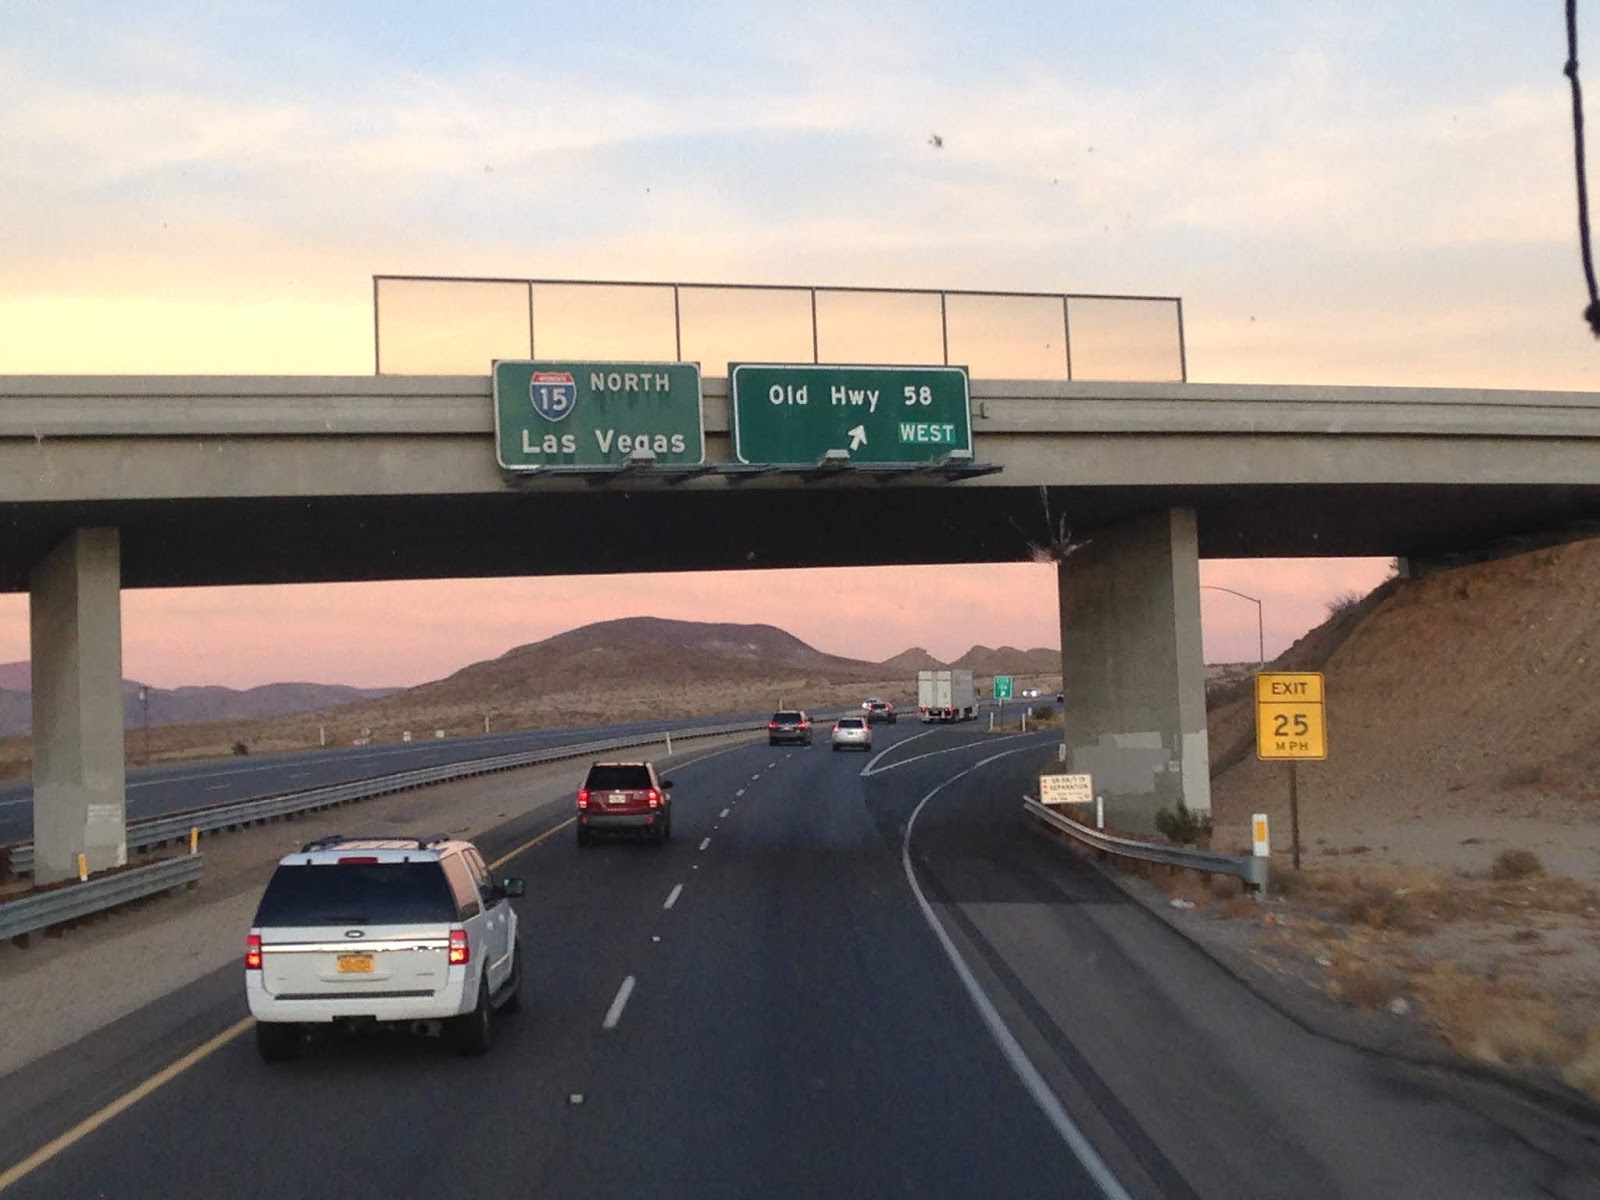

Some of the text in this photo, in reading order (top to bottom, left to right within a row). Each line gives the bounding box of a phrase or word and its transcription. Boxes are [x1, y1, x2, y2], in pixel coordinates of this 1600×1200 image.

[590, 373, 669, 392] NORTH
[540, 388, 567, 410] 15
[768, 384, 933, 413] Old Hwy 58
[522, 429, 685, 453] Las Vegas
[900, 425, 954, 442] WEST
[1272, 682, 1307, 695] EXIT
[1274, 714, 1308, 737] 25
[1276, 741, 1309, 751] MPH
